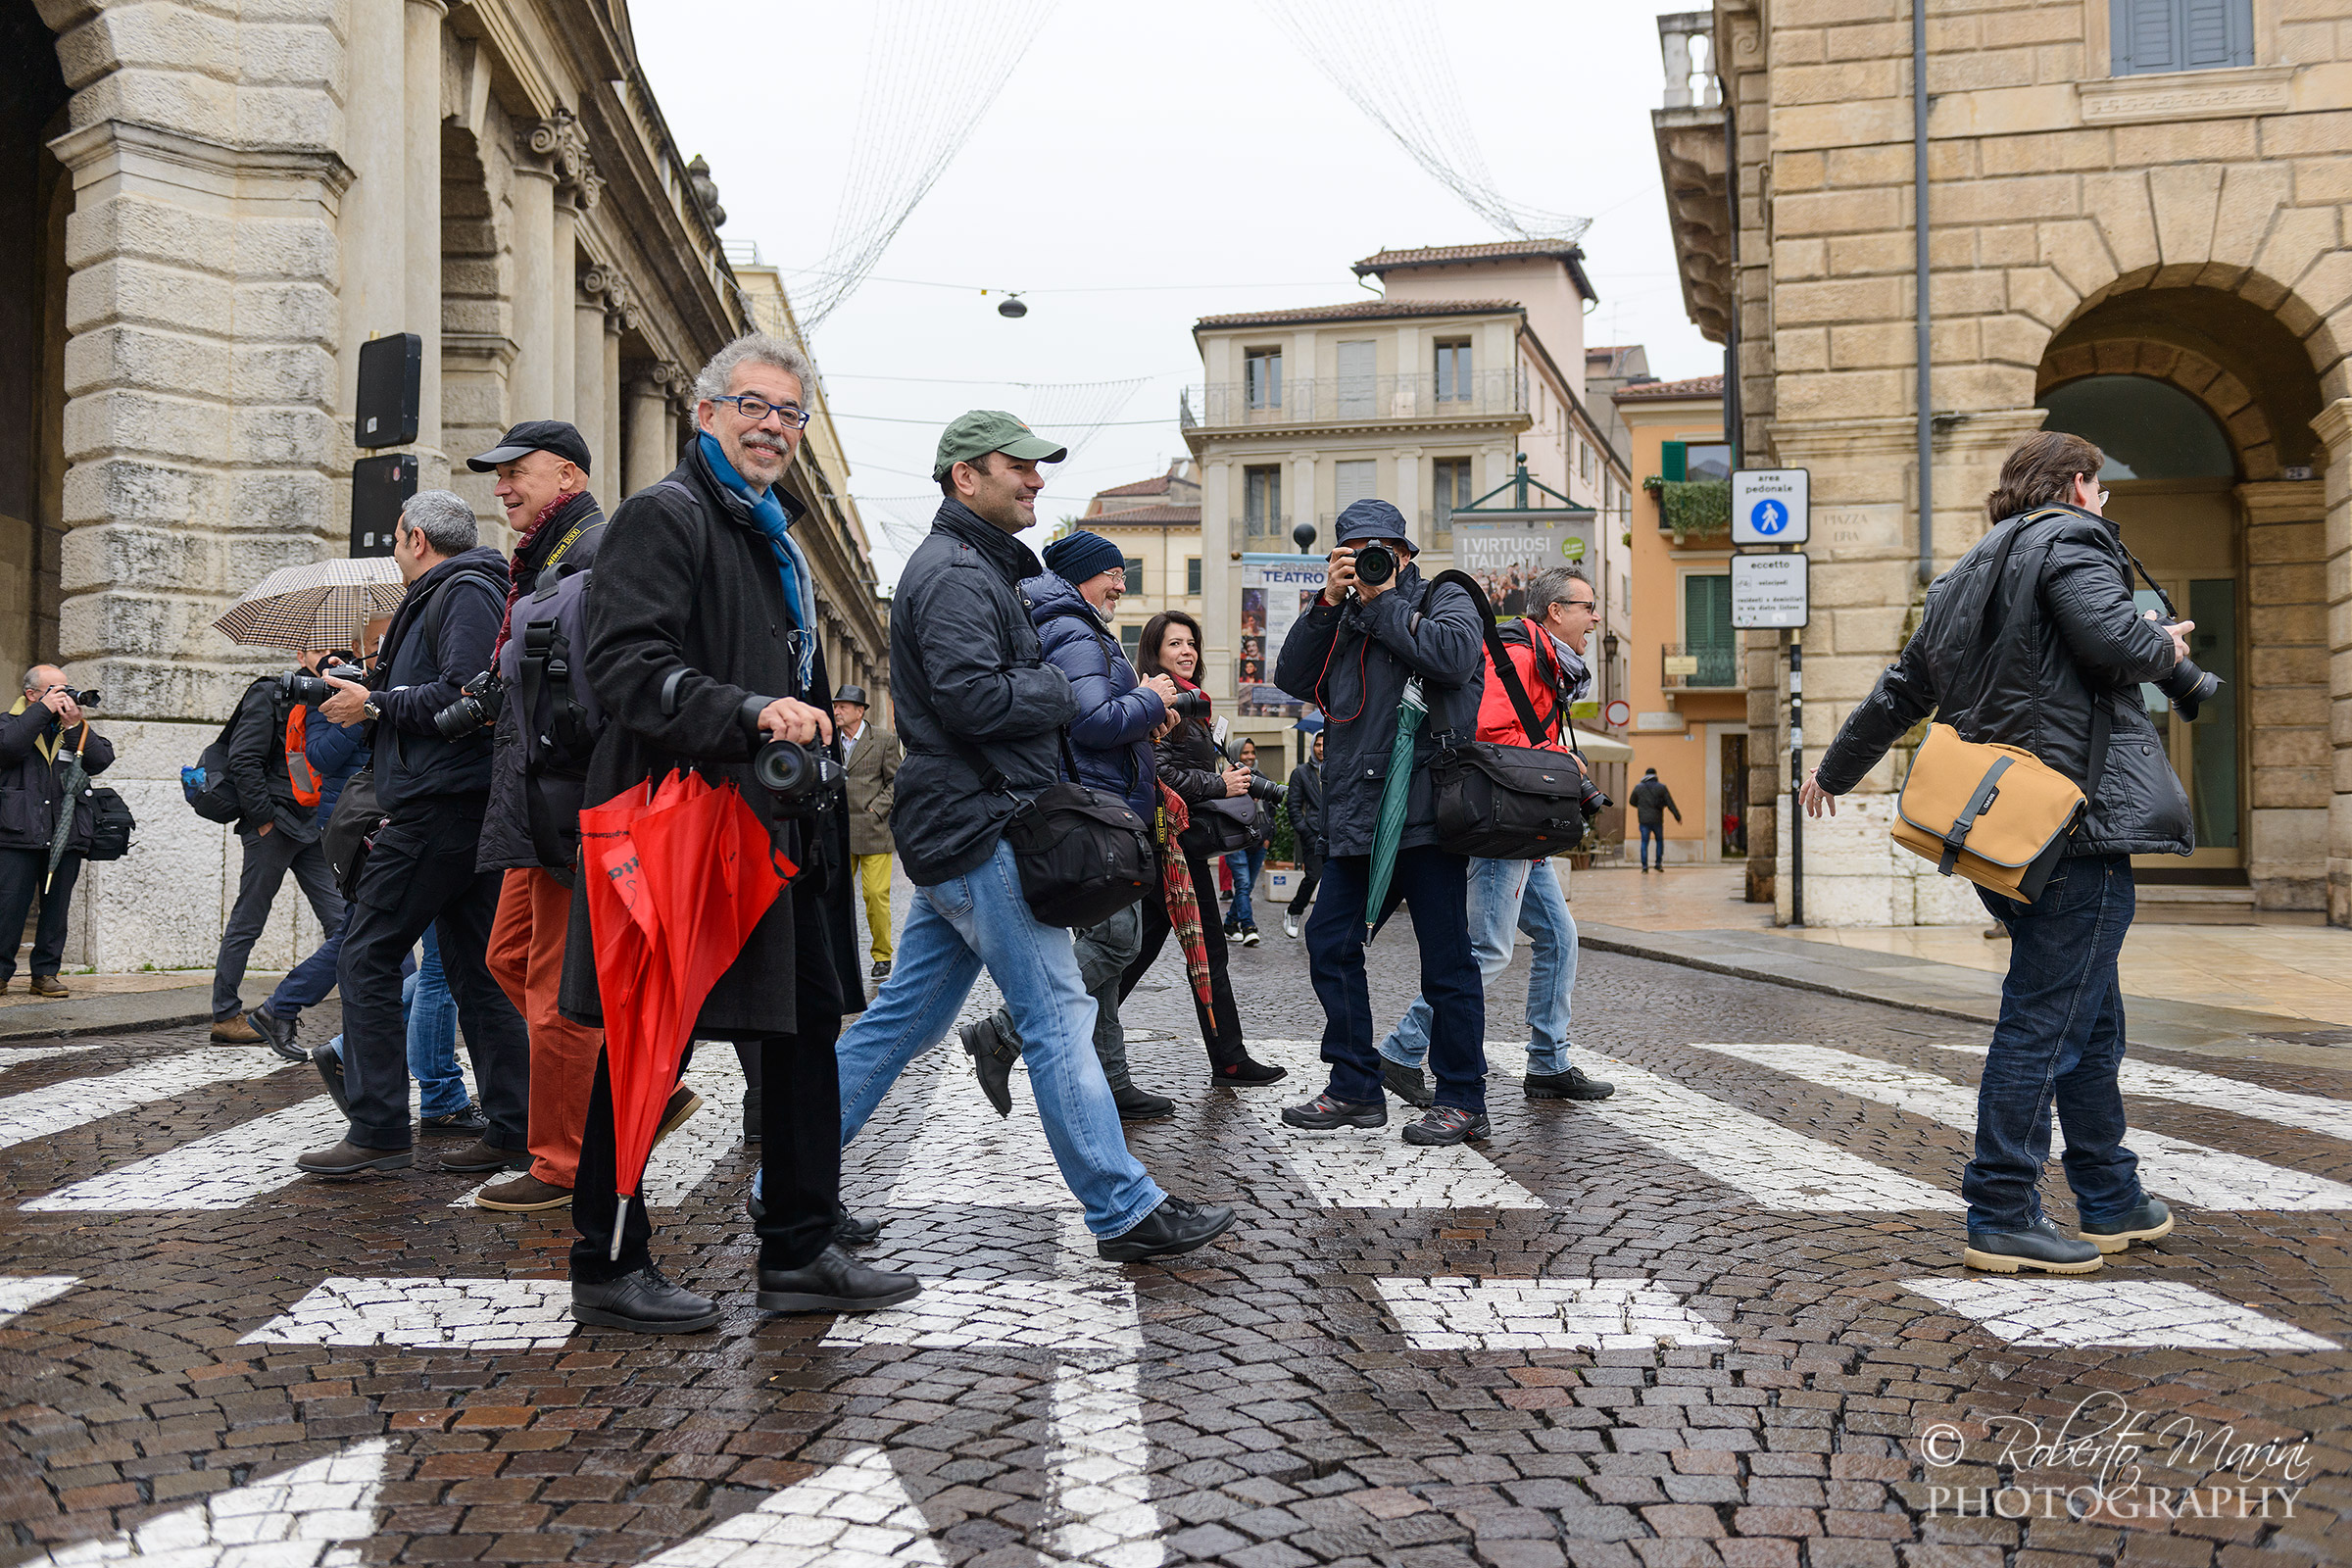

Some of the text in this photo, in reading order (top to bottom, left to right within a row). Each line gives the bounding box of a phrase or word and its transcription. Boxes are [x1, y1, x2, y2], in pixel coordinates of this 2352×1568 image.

[1746, 485, 1792, 494] pedonale
[1824, 514, 1868, 525] PIAZZA
[1834, 531, 1859, 542] BRA
[1463, 537, 1550, 553] I VIRTUOSI
[547, 544, 566, 566] Nikon
[1463, 554, 1536, 569] ITALIANI
[1750, 561, 1789, 569] eccetto
[1262, 571, 1324, 584] TEATRO
